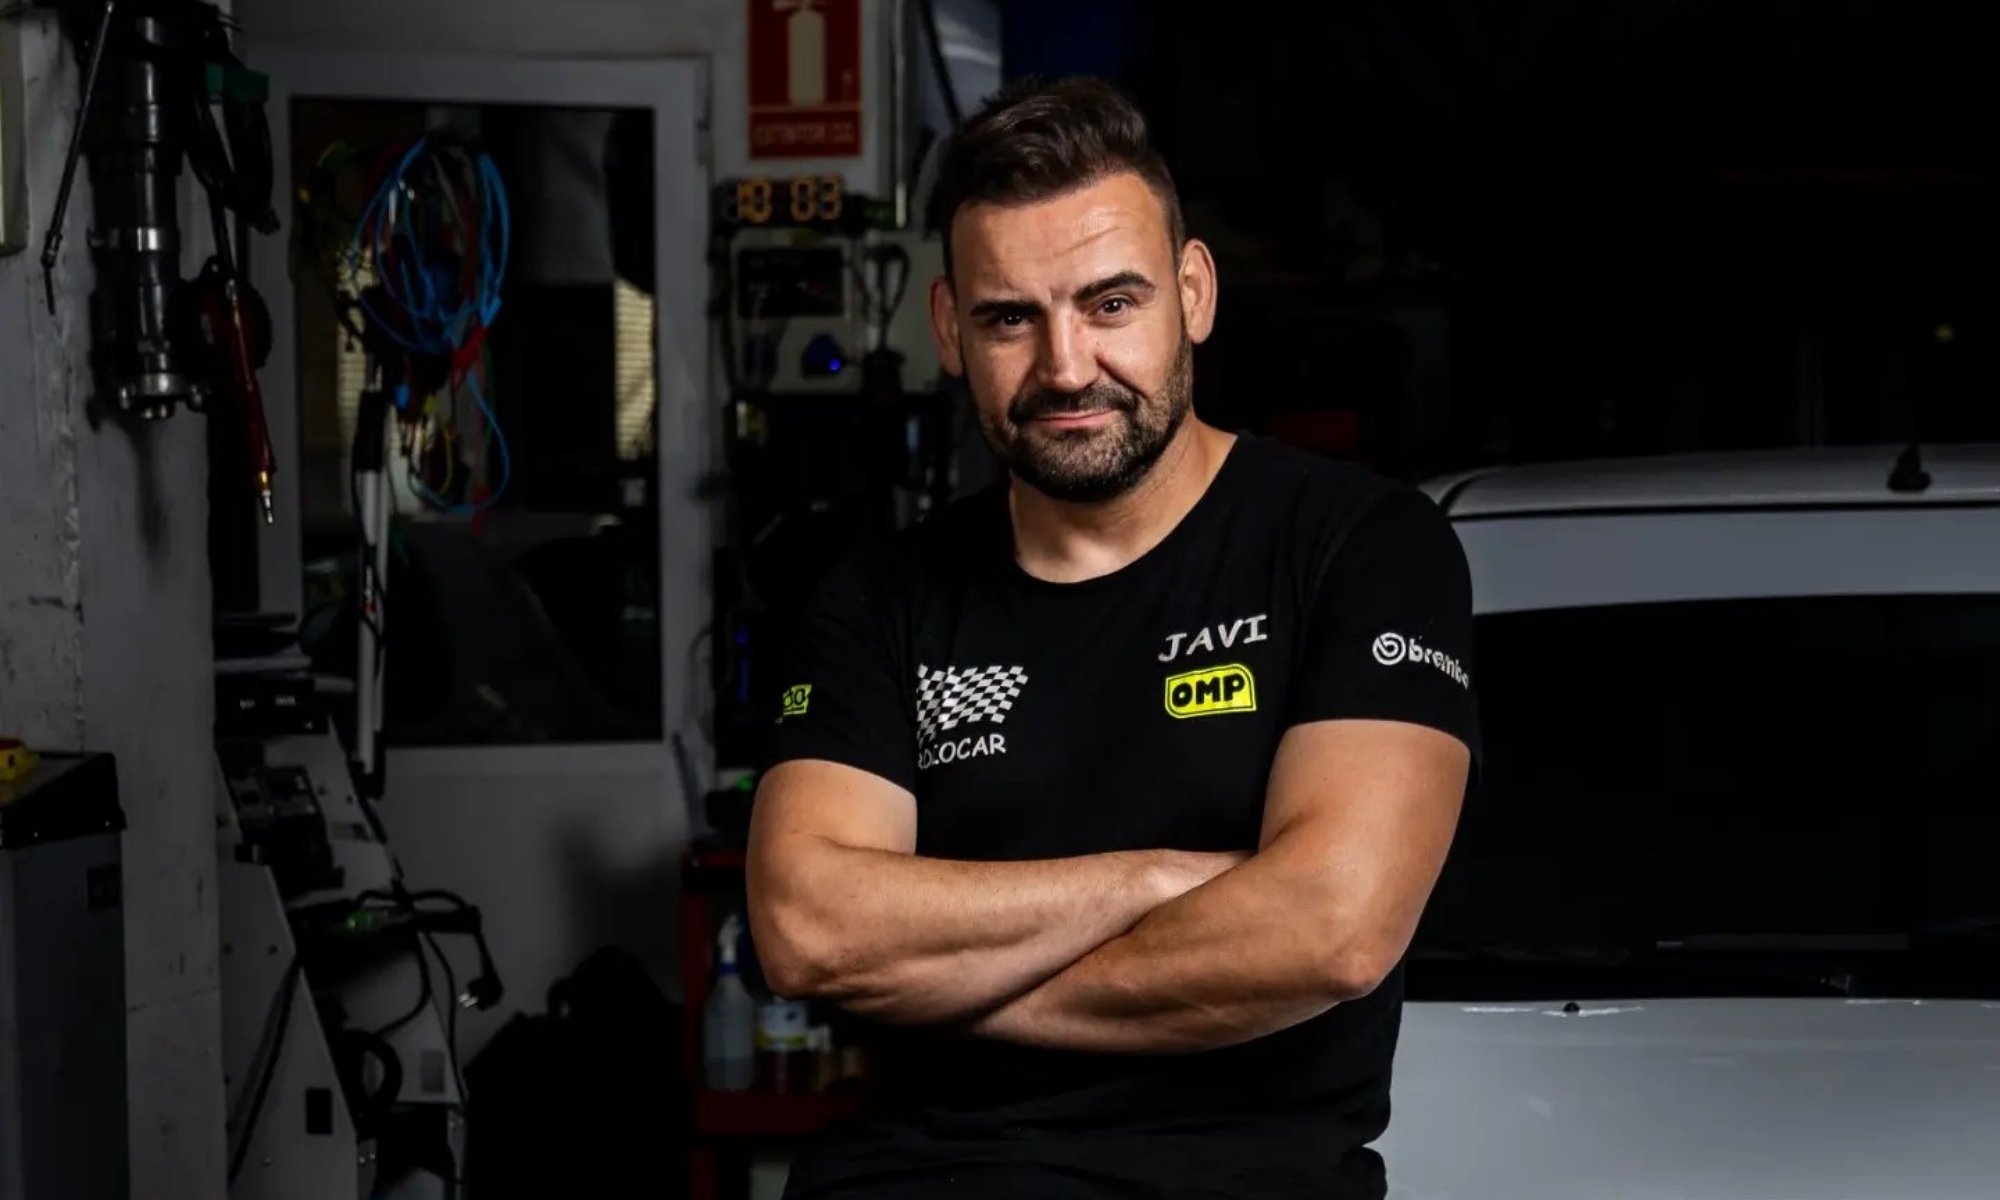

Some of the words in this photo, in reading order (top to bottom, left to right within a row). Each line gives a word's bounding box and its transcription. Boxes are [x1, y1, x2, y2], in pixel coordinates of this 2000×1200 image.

[1157, 613, 1268, 663] JAVI
[1408, 637, 1469, 690] brembo
[1171, 672, 1246, 708] OMP
